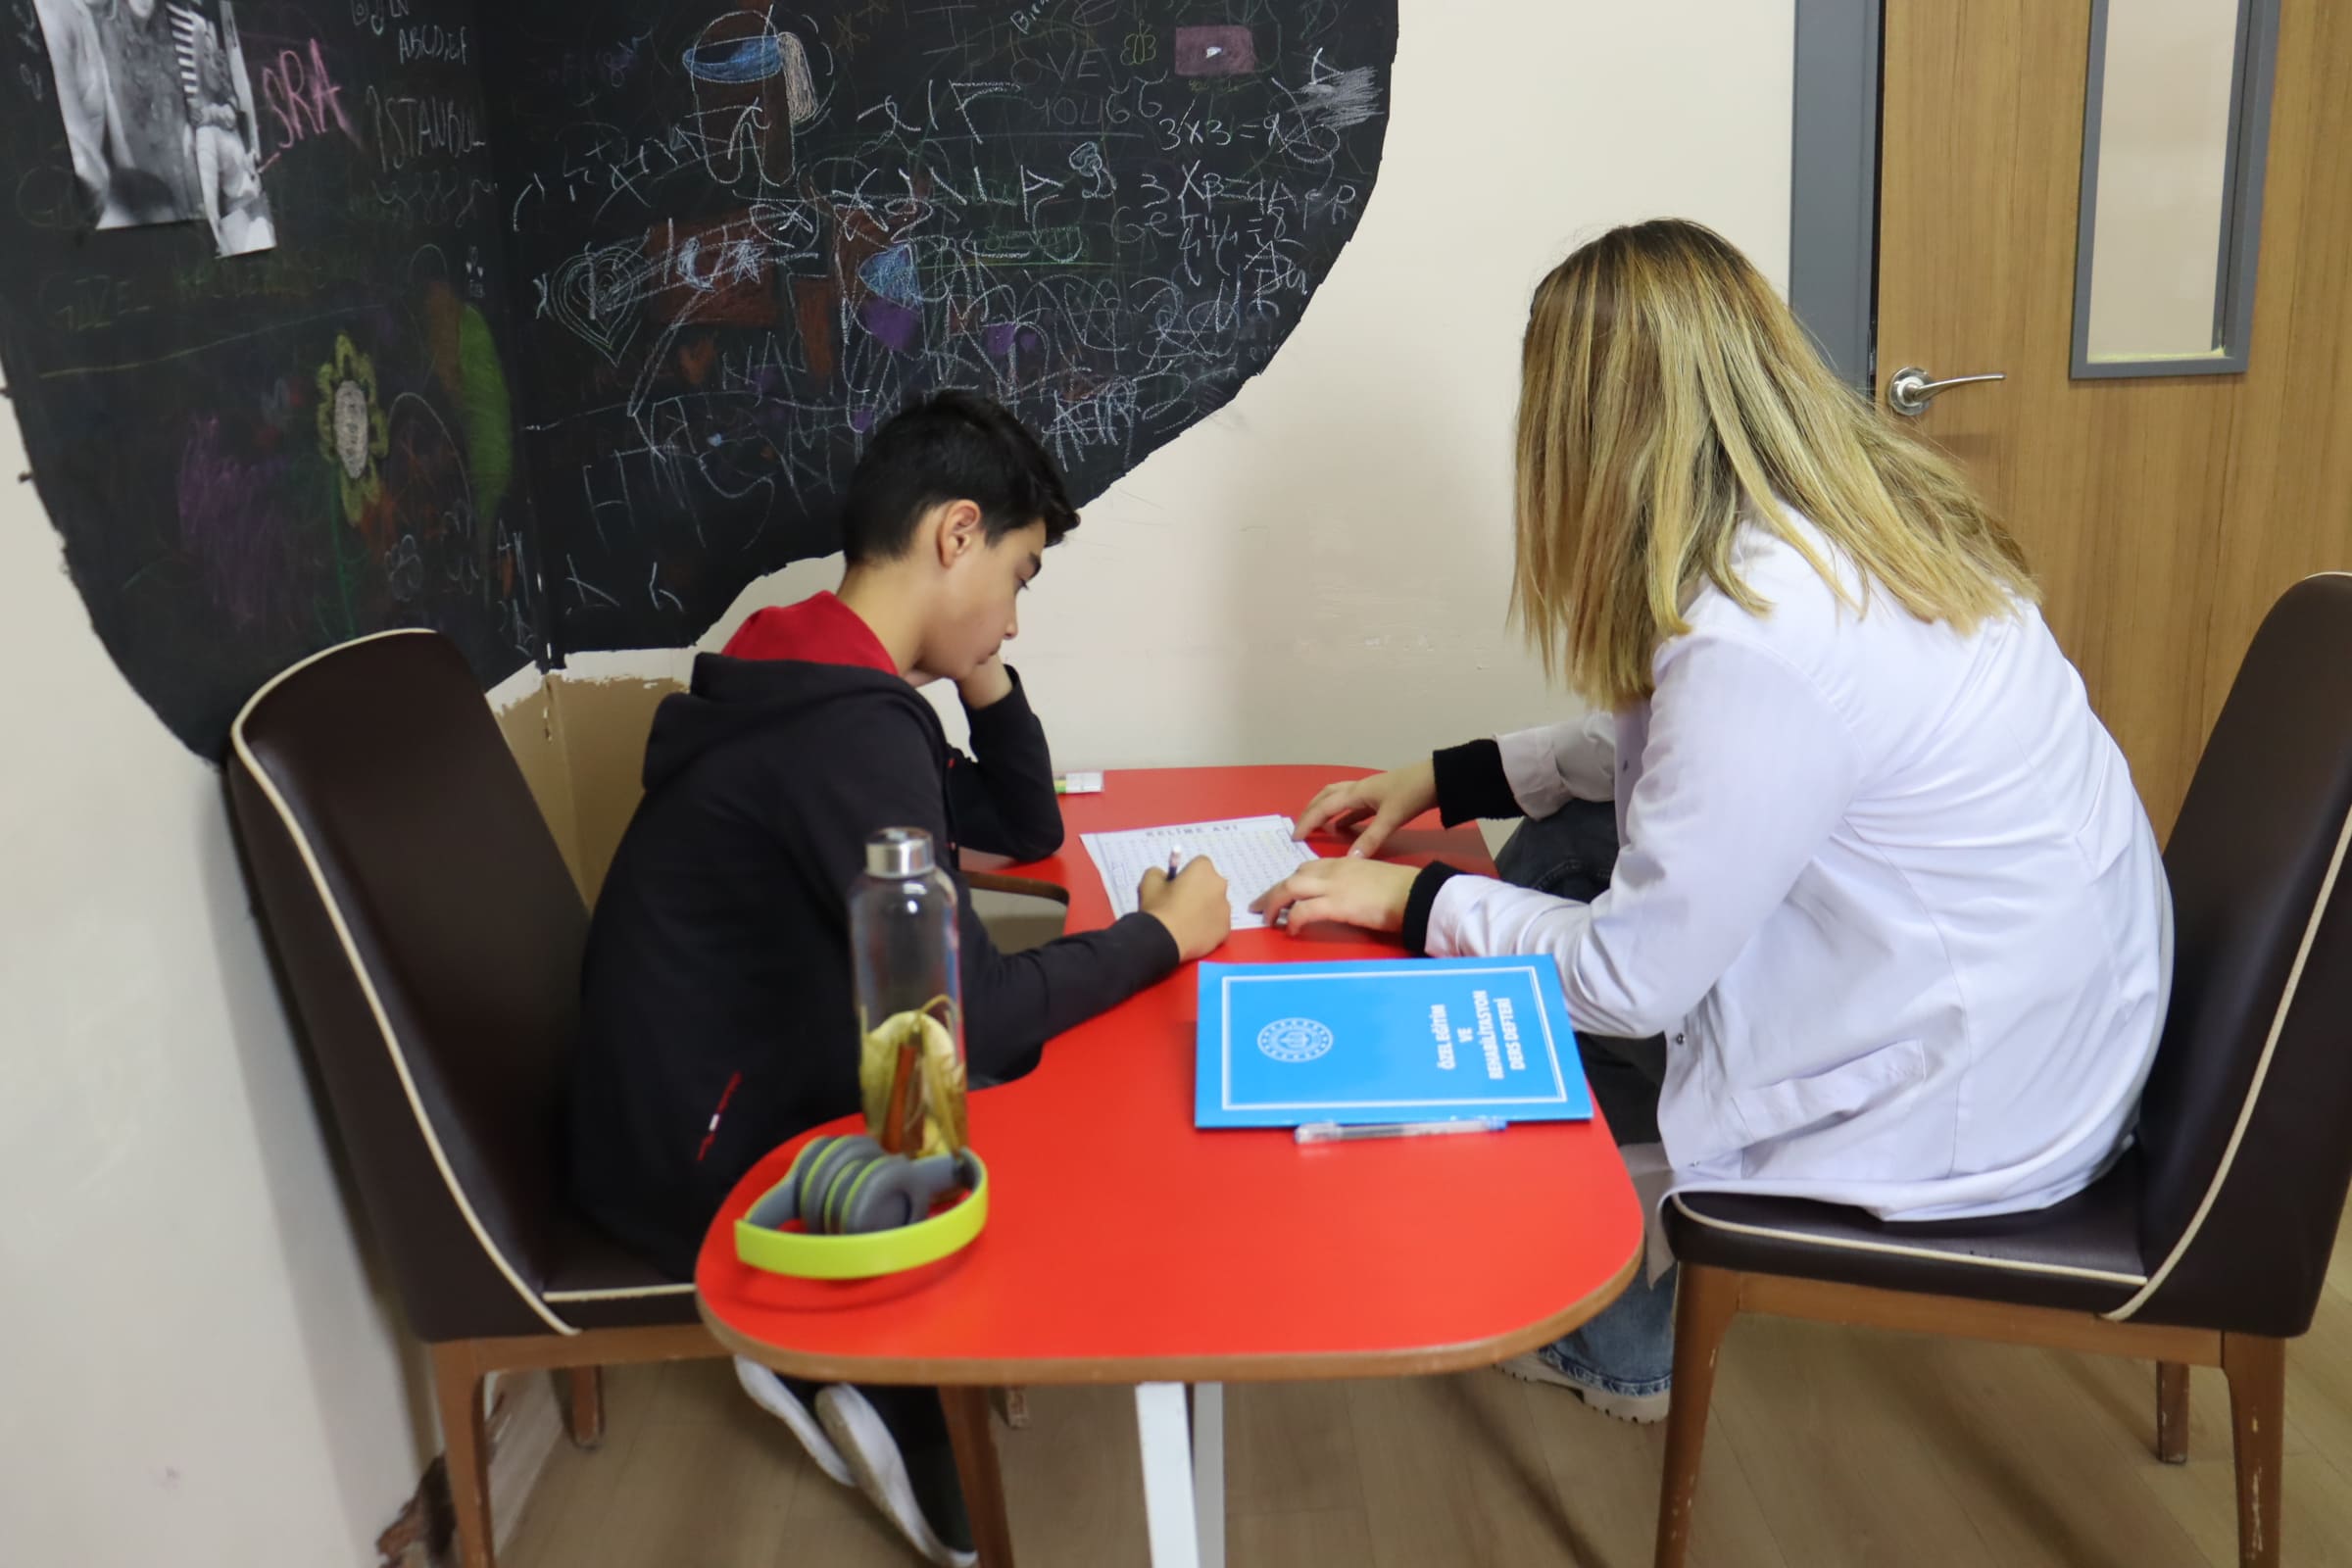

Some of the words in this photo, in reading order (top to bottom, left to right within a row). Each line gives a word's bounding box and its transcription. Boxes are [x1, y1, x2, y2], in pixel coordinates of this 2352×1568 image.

[1429, 1004, 1451, 1042] EĞİTİM
[1456, 1027, 1474, 1043] VE
[1472, 990, 1504, 1080] REHABİLİTASYON
[1493, 998, 1519, 1041] DEFTERİ
[1437, 1043, 1456, 1070] ÖZEL
[1505, 1041, 1526, 1070] DERS
